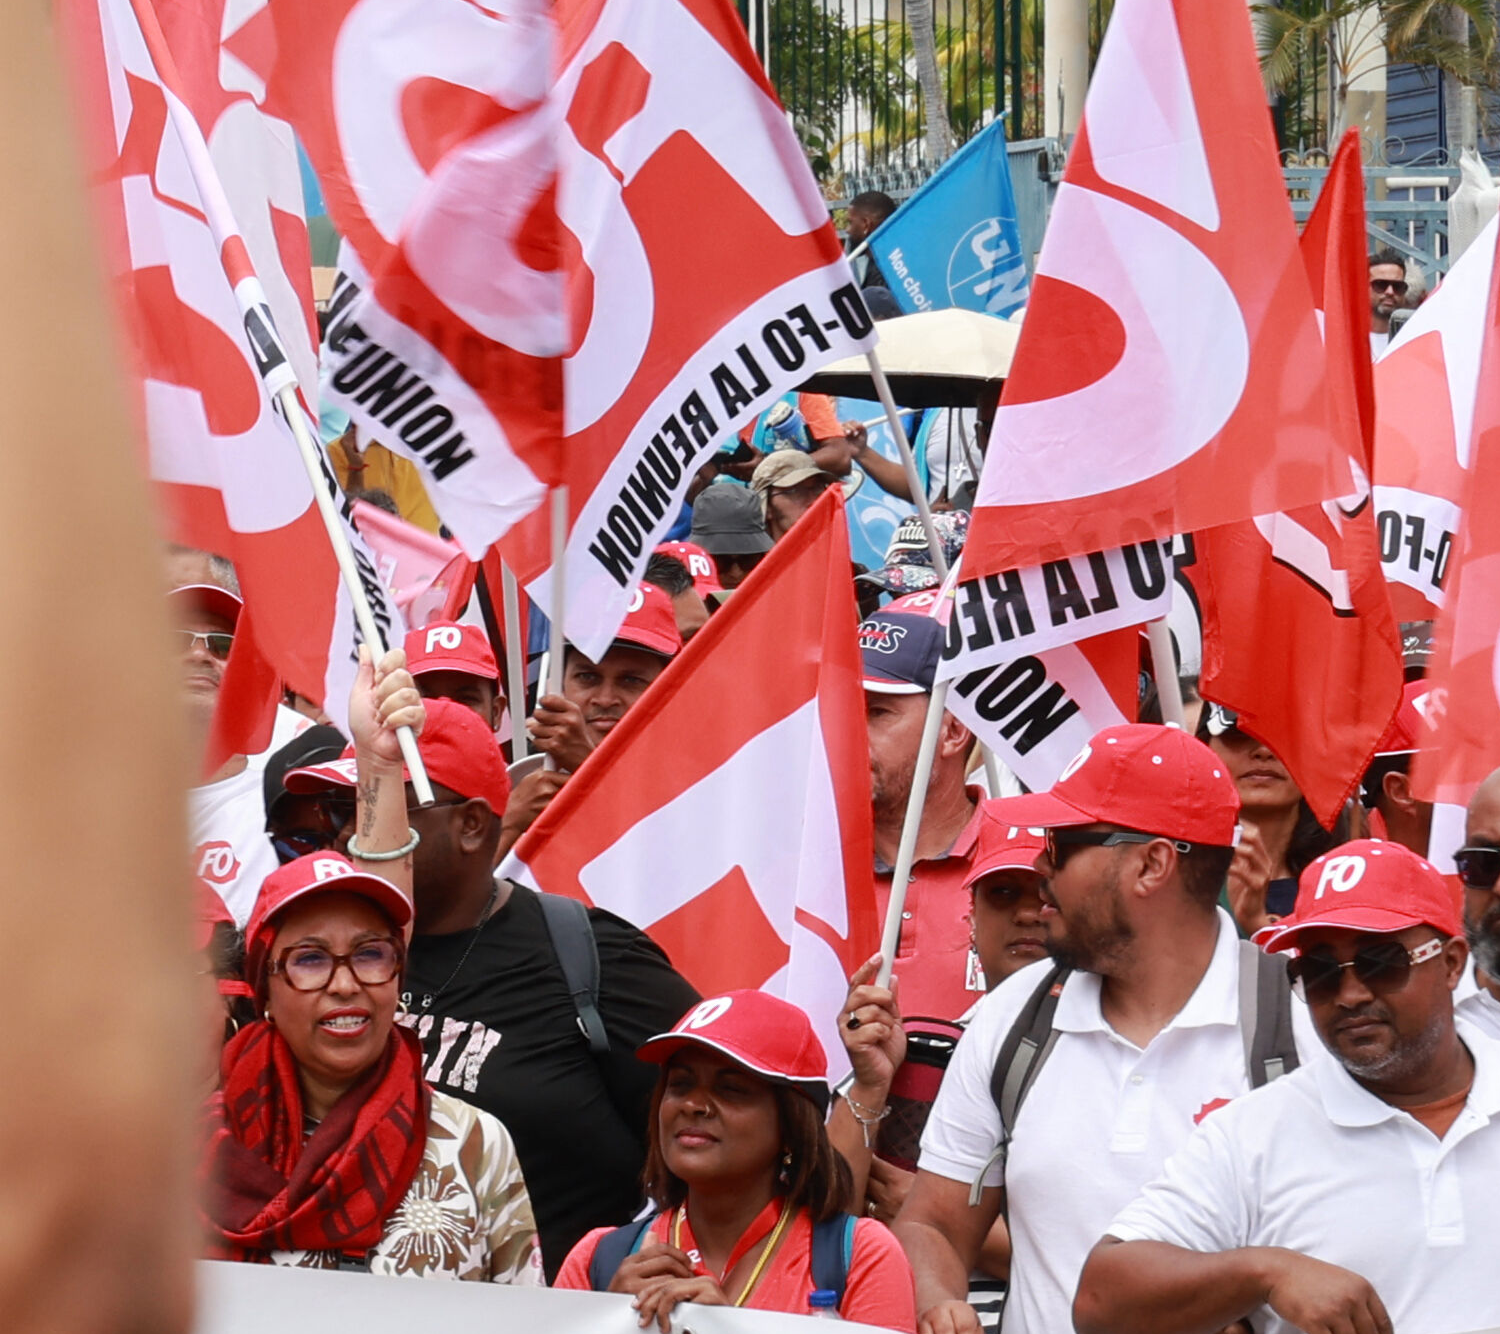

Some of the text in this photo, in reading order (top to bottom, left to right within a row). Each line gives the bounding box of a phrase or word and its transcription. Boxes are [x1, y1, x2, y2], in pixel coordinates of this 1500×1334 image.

[689, 555, 710, 576] FO
[425, 627, 462, 654] FO
[858, 621, 908, 655] RIS
[197, 850, 234, 877] FO
[1315, 857, 1365, 901] FO
[679, 996, 732, 1031] FO
